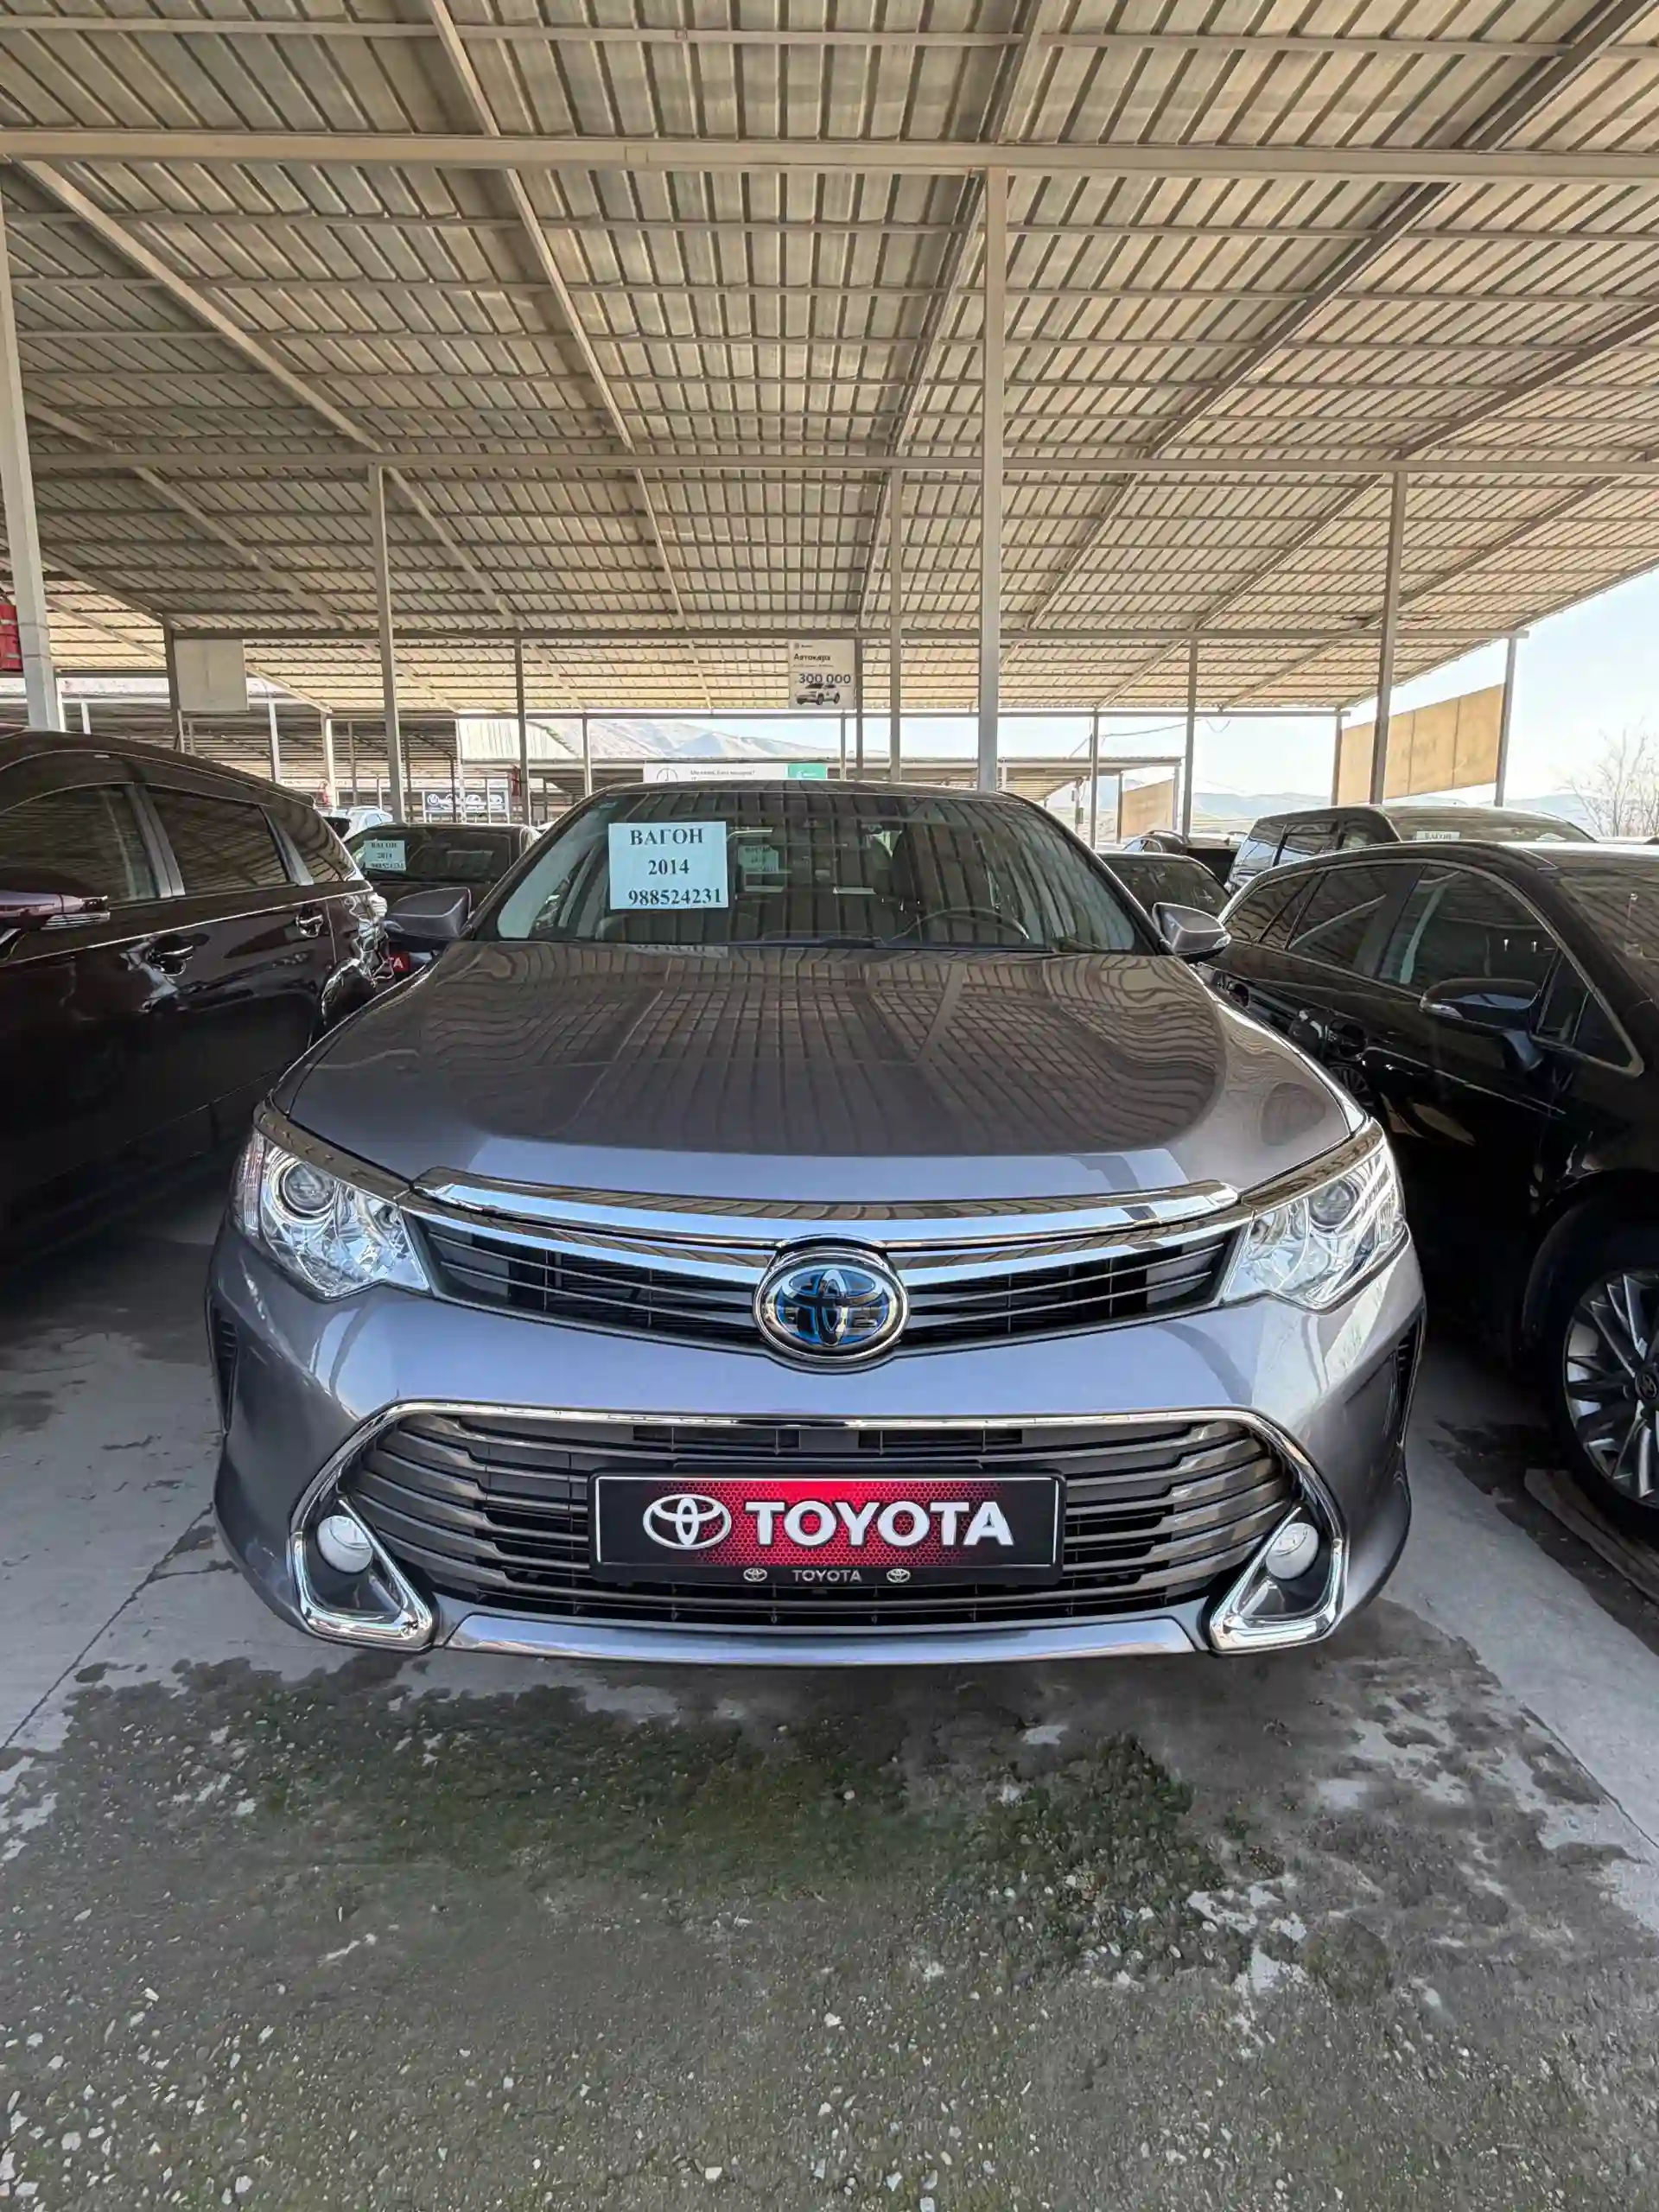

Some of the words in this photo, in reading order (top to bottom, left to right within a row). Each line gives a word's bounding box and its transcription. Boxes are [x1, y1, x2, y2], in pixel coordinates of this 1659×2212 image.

[798, 673, 823, 684] 300
[826, 673, 851, 684] 000
[629, 828, 704, 846] ВАГОН
[648, 859, 690, 875] 2014
[628, 887, 721, 906] 988524231
[745, 1500, 1014, 1547] TOYOTA
[791, 1568, 862, 1583] TOYOTA
